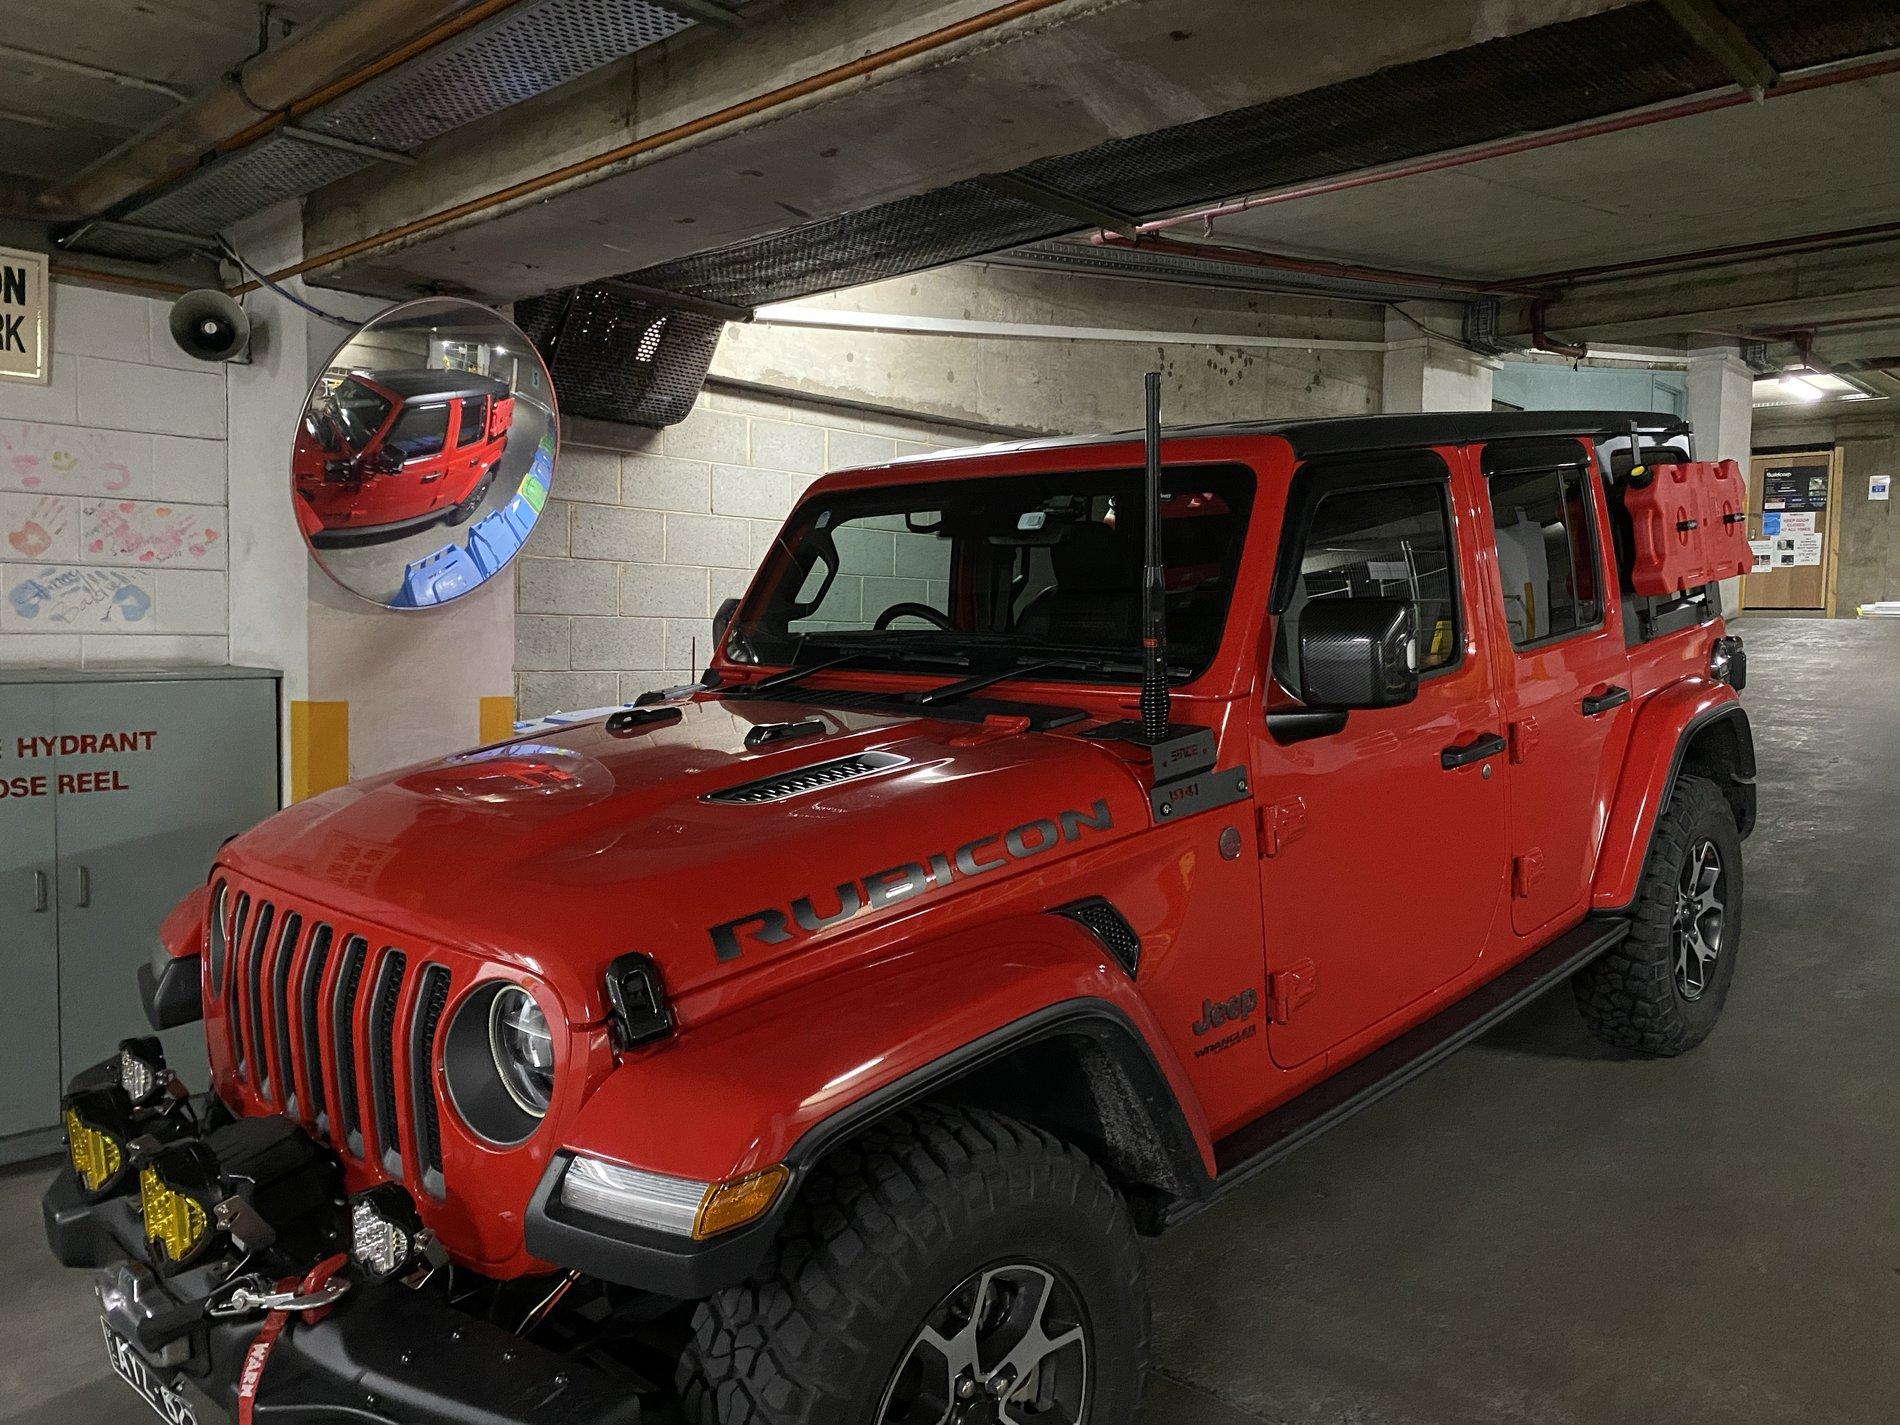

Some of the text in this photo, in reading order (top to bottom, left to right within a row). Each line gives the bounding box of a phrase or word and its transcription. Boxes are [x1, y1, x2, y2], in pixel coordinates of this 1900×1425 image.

[0, 265, 26, 306] N
[0, 313, 26, 353] K
[17, 731, 157, 758] HYDRANT
[58, 770, 129, 794] REEL
[707, 799, 1115, 963] RUBICON
[1192, 988, 1258, 1036] Jeep
[1194, 1024, 1257, 1059] WRANGLER
[240, 1343, 270, 1397] WARN
